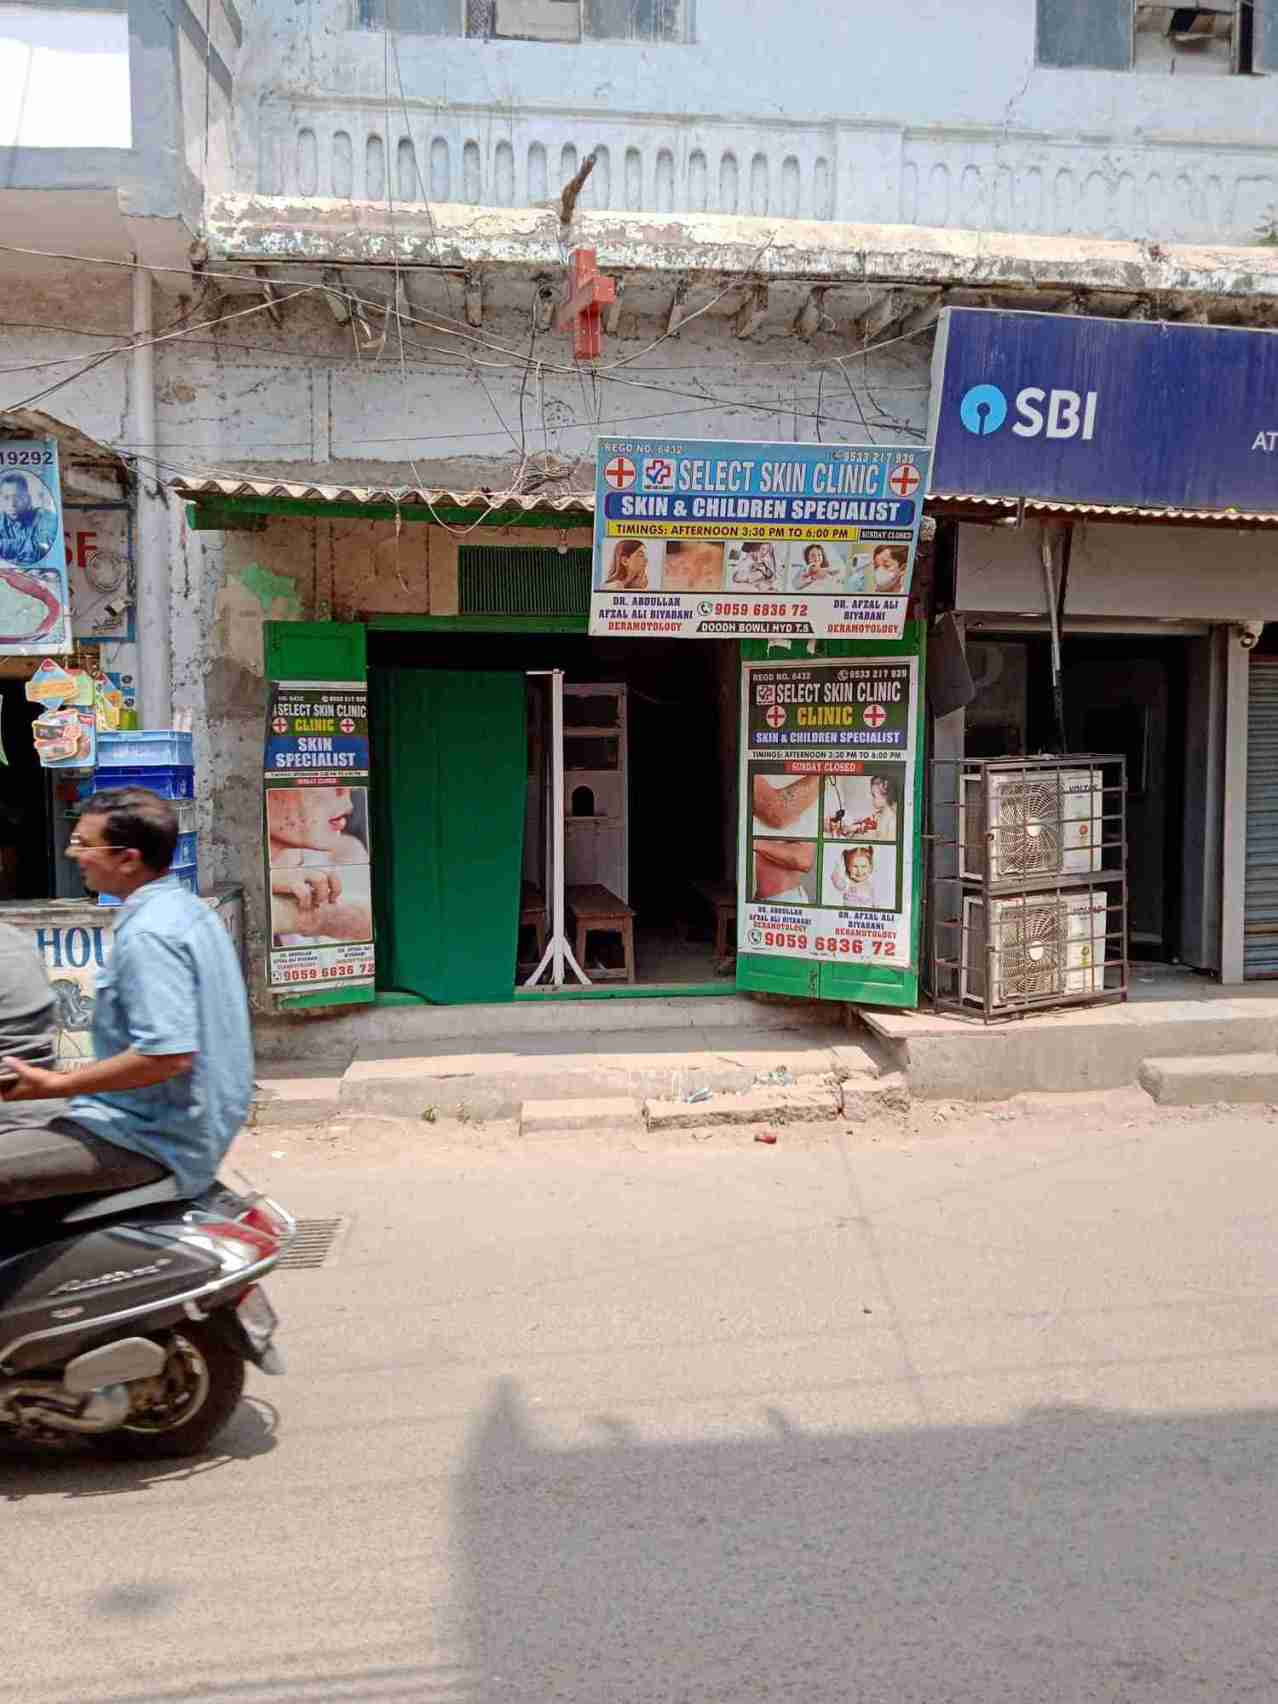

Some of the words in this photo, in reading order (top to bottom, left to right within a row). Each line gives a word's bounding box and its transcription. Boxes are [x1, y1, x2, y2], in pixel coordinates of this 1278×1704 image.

[1012, 387, 1098, 440] SBI
[678, 458, 755, 492] SELECT
[759, 462, 807, 494] SKIN
[812, 463, 880, 496] CLINIC
[621, 495, 669, 517] SKIN
[672, 499, 688, 517] &
[692, 497, 787, 519] CHILDREN
[791, 500, 900, 521] SPECIALIST
[616, 524, 668, 535] TIMINGS:
[670, 525, 739, 536] AFTERNOON
[741, 526, 765, 537] 3:30
[769, 528, 785, 537] PM
[788, 528, 803, 538] TO
[806, 528, 829, 538] 6:00
[833, 529, 849, 539] PM
[631, 596, 681, 607] ABDULLAH
[883, 600, 898, 609] ALI
[632, 609, 647, 619] ALI
[714, 602, 748, 617] 9059
[752, 603, 786, 618] 6836
[792, 604, 809, 617] 72
[738, 623, 769, 633] BOWLI
[776, 682, 821, 703] SELECT
[823, 682, 853, 703] SKIN
[856, 681, 901, 703] CLINIC
[278, 703, 312, 717] SELECT
[313, 704, 335, 717] SKIN
[336, 703, 367, 719] CLINIC
[797, 705, 854, 726] CLINIC
[294, 718, 336, 732] CLINIC
[297, 737, 333, 752] SKIN
[756, 732, 779, 744] SKIN
[780, 733, 789, 744] &
[789, 731, 838, 744] CHILDREN
[839, 731, 901, 744] SPECIALIST
[275, 752, 356, 768] SPECIALIST
[784, 751, 827, 760] AFTERNOON
[764, 931, 808, 950] 9059
[815, 936, 864, 955] 6836
[871, 940, 897, 957] 72
[283, 968, 318, 981] 9059
